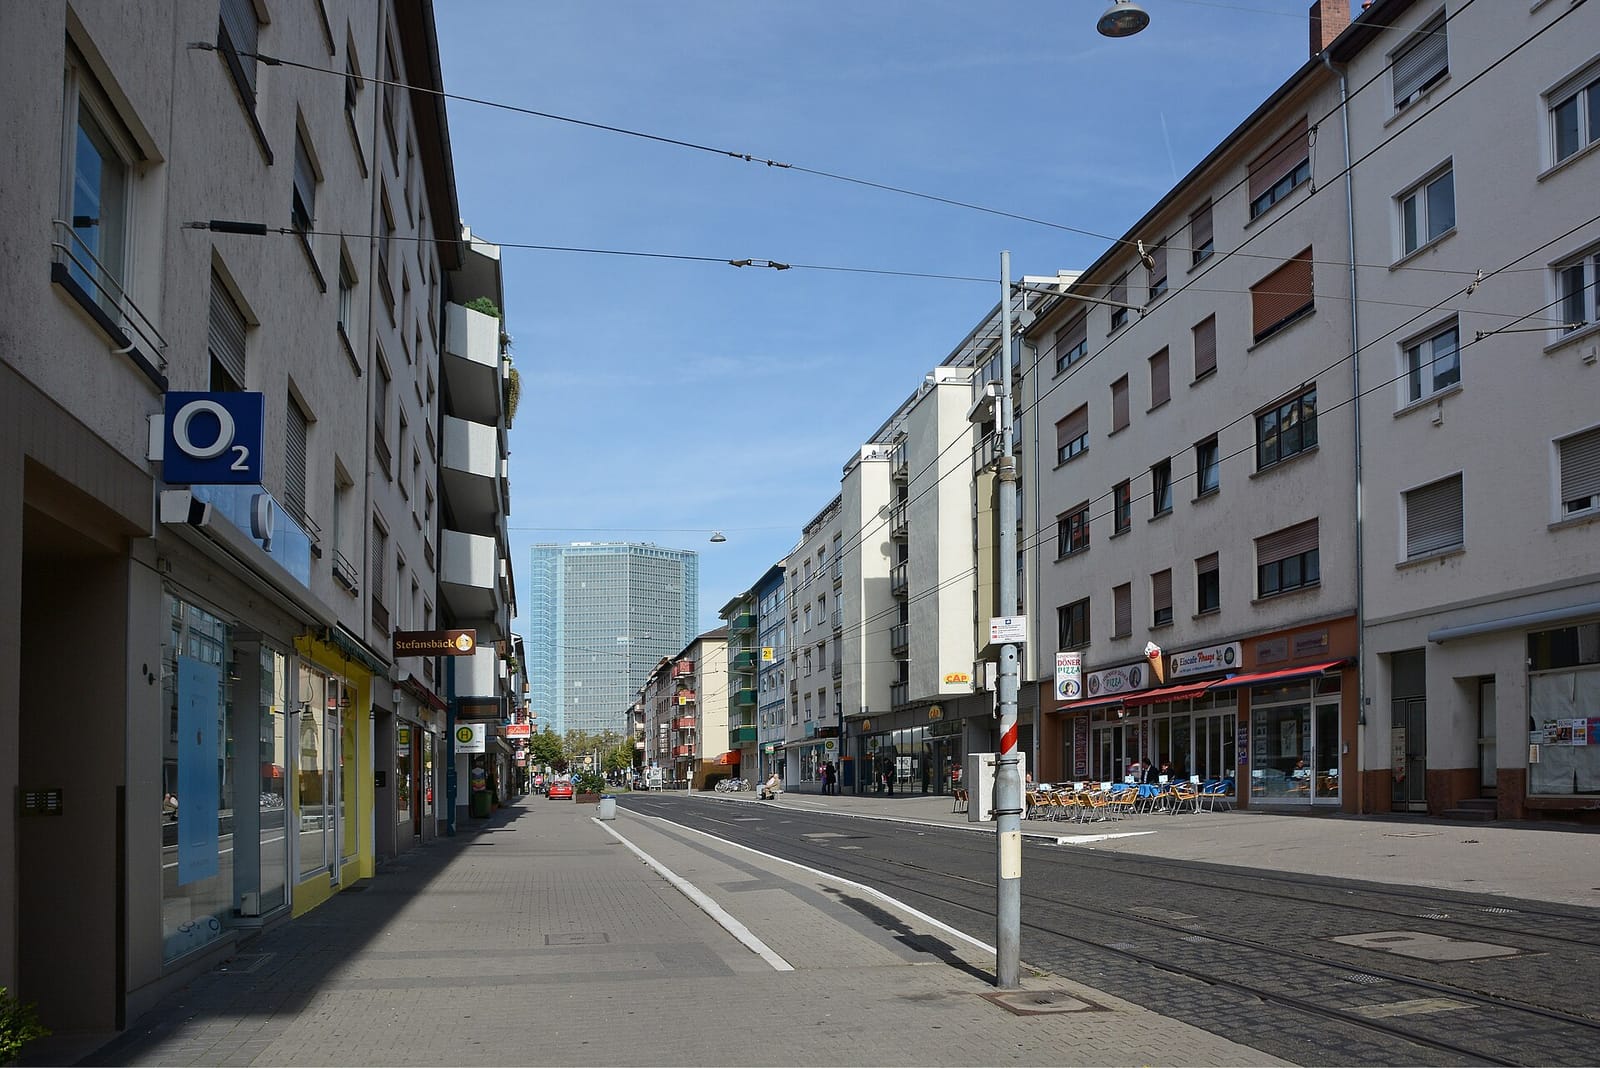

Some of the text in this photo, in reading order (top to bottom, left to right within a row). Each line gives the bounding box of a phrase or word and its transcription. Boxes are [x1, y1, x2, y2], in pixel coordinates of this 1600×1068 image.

[173, 400, 249, 470] O2
[396, 638, 455, 650] Stefansbäck
[1057, 658, 1081, 666] DÖNER
[1057, 666, 1081, 675] PIZZA
[946, 674, 967, 682] CAP
[1106, 676, 1122, 687] PIZZA
